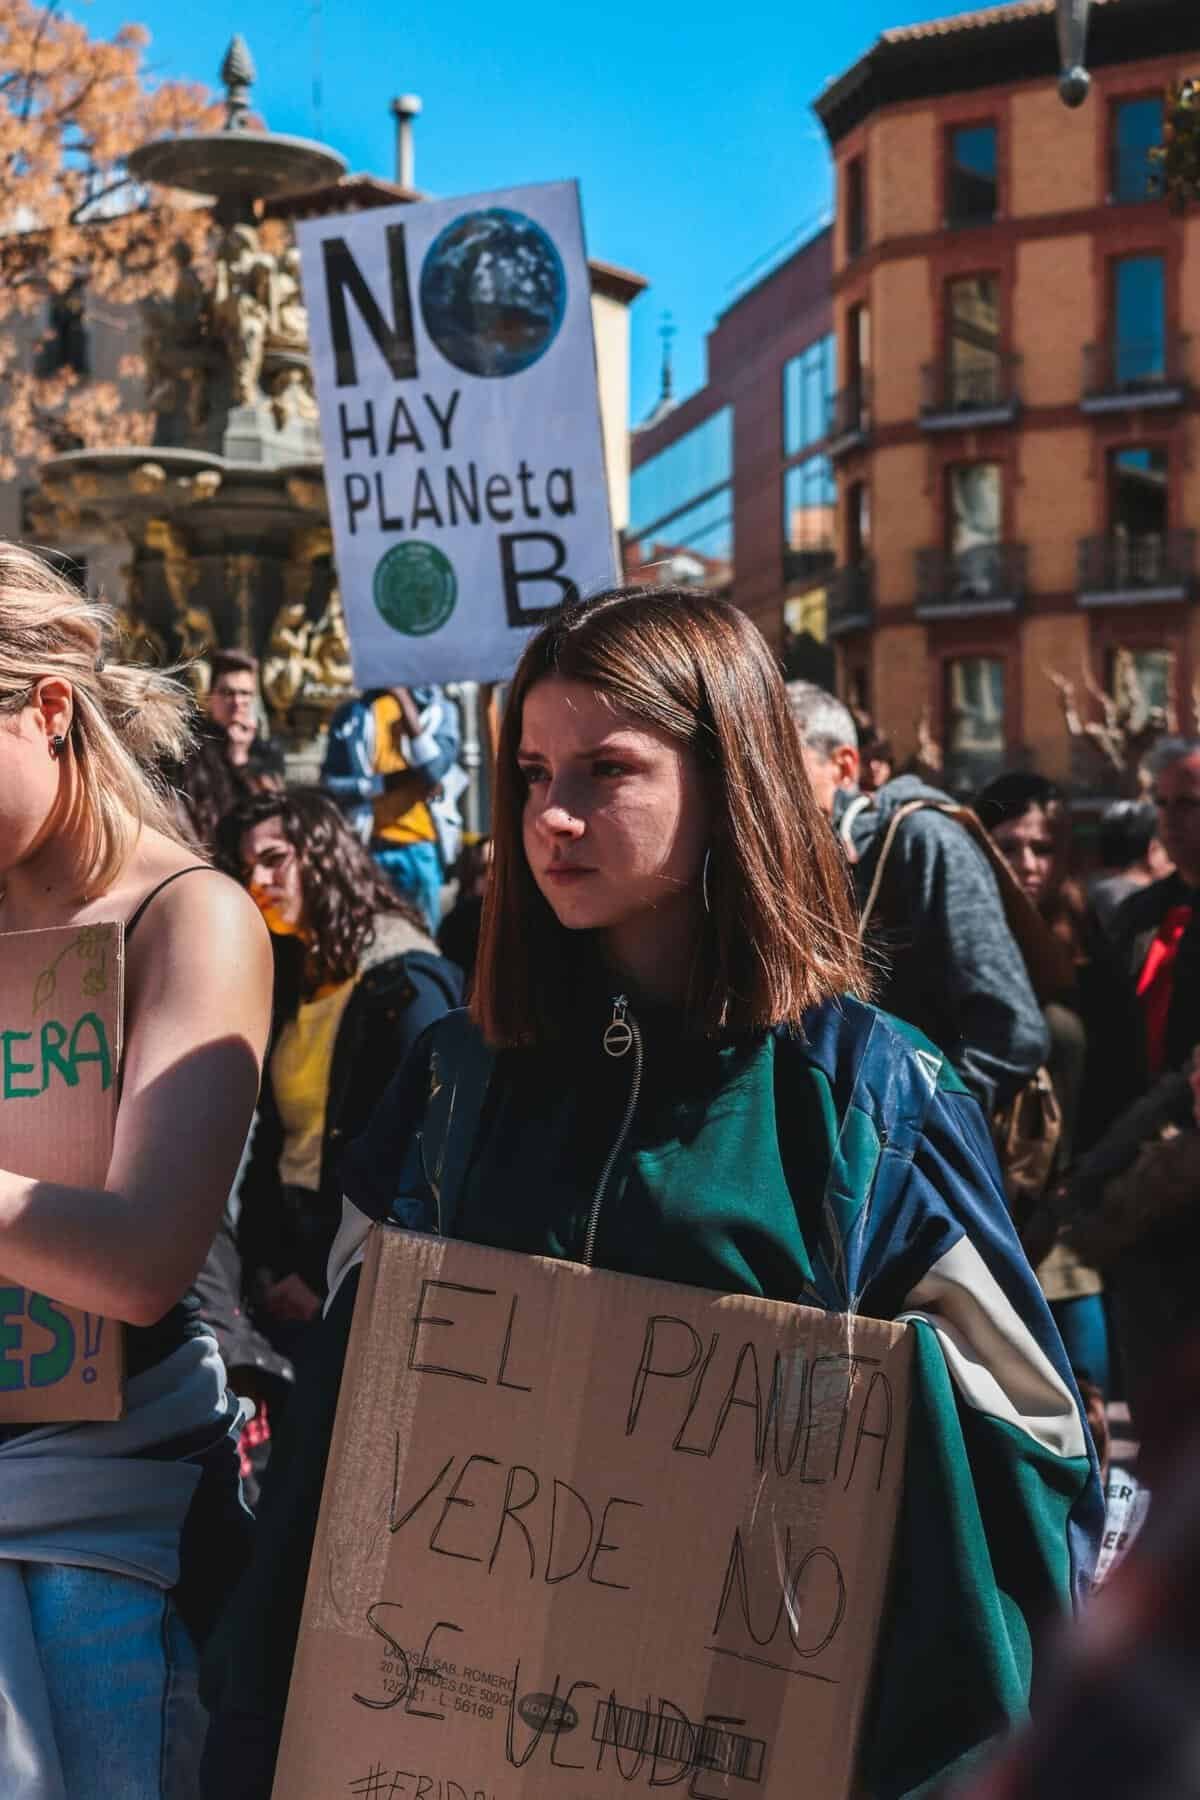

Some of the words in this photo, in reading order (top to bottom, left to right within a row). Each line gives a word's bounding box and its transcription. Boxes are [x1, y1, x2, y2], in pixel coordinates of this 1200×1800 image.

[338, 390, 461, 459] HAY
[344, 460, 577, 535] PLANeta
[498, 531, 582, 629] B
[408, 1279, 533, 1392] EL
[625, 1314, 893, 1492] PLANETA
[390, 1431, 643, 1590] VERDE
[712, 1526, 847, 1658] NO
[352, 1602, 464, 1721] SE
